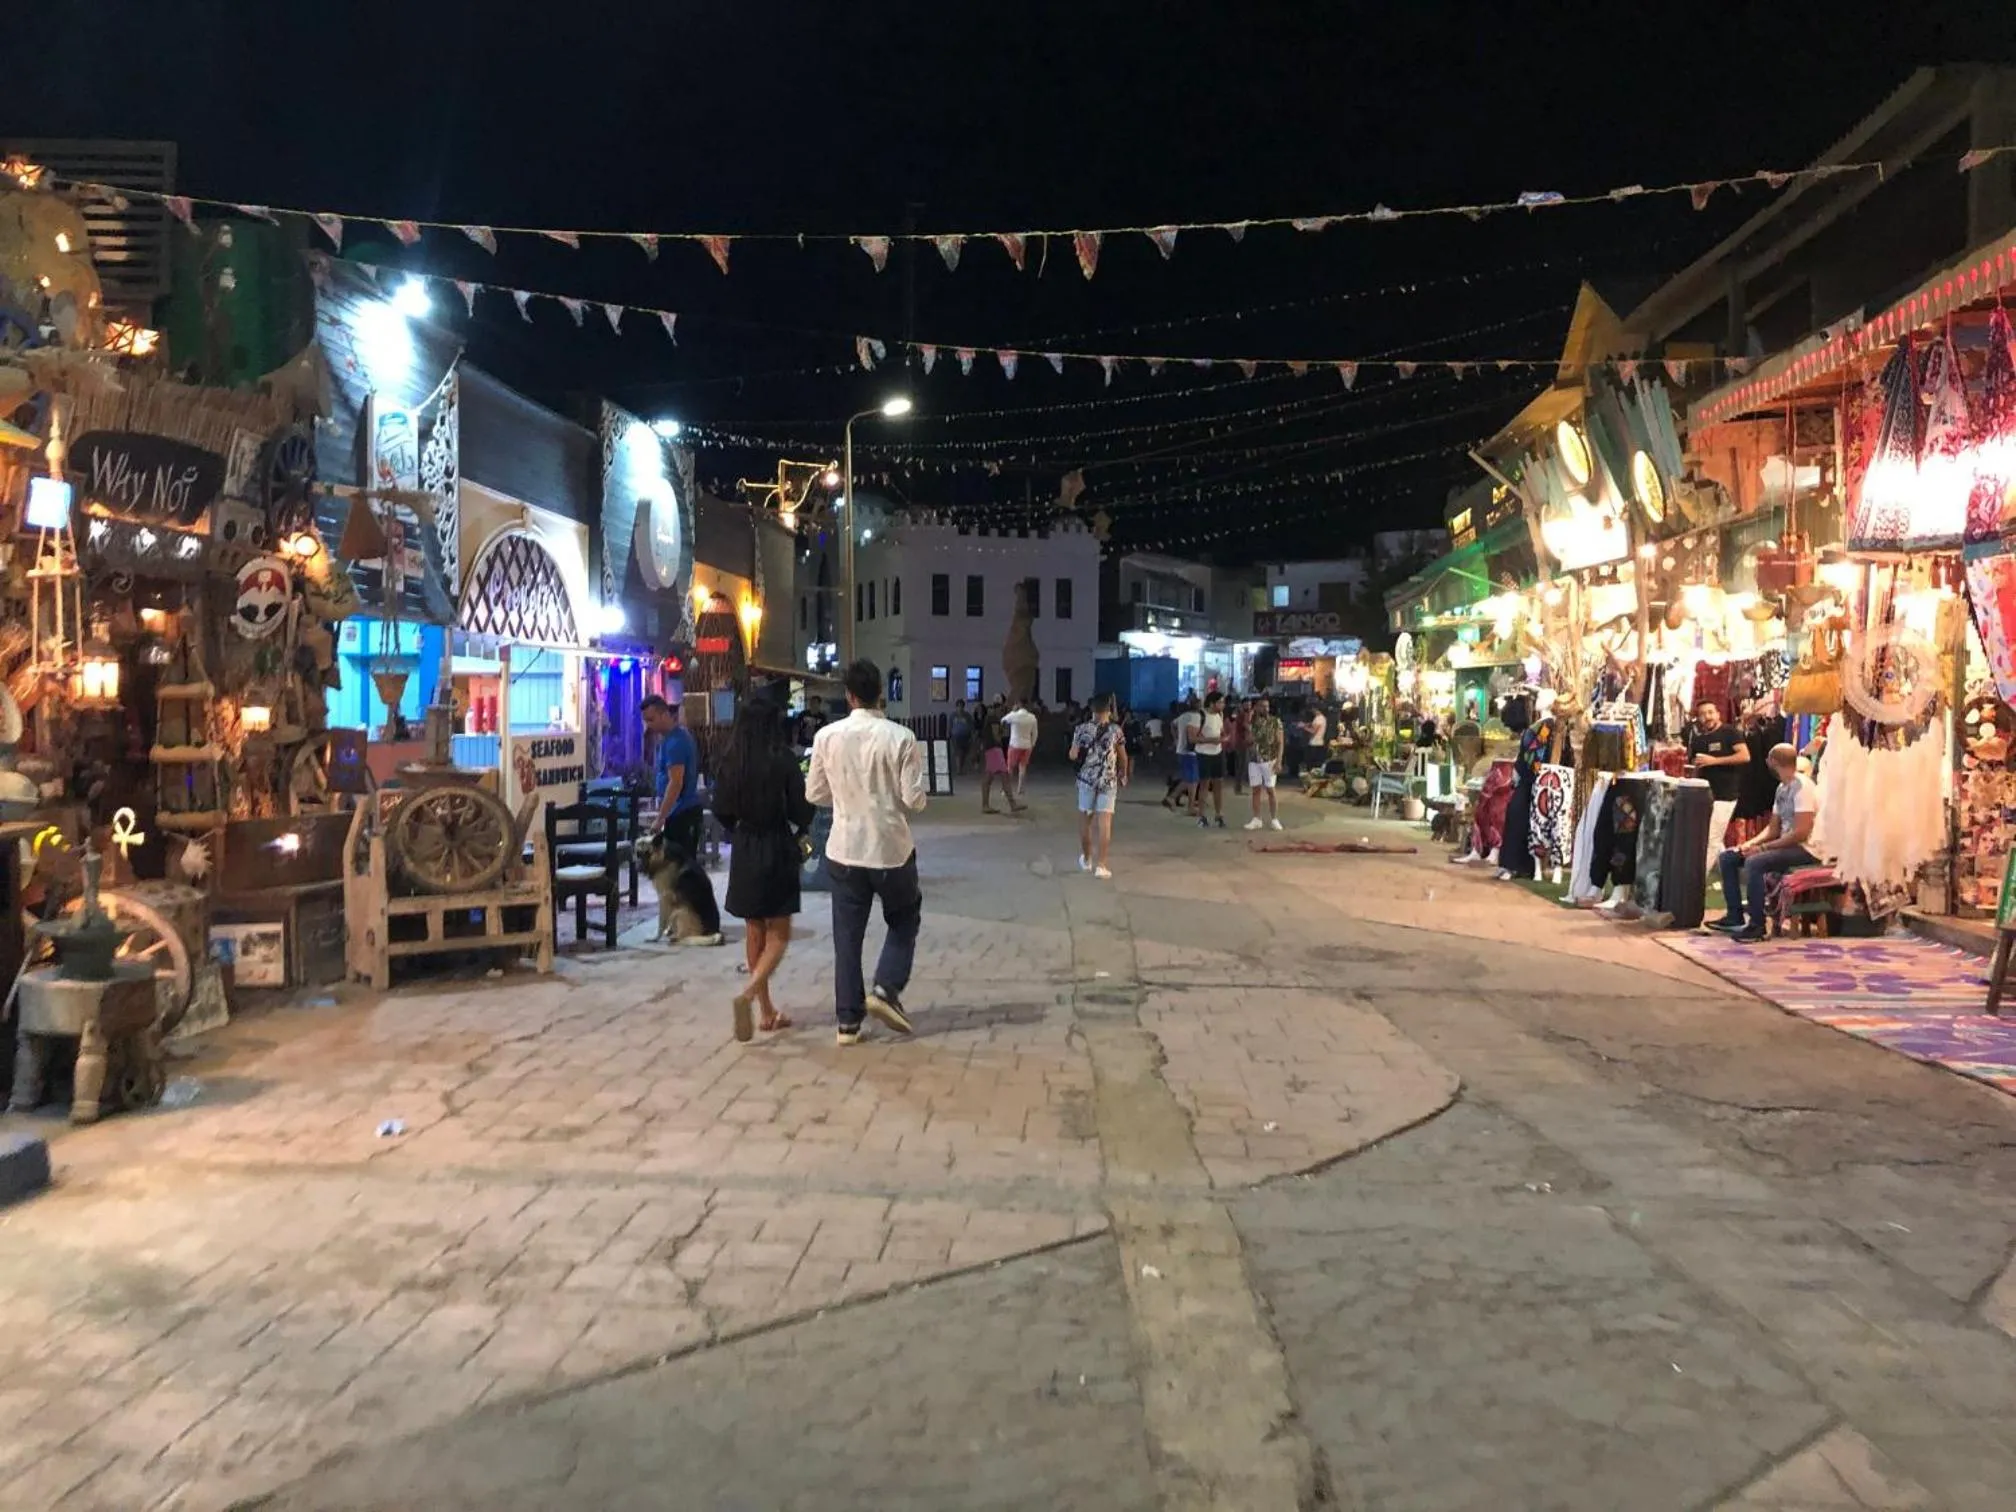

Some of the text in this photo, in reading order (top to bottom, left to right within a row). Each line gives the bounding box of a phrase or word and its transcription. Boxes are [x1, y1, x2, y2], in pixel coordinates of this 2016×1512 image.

[1276, 612, 1340, 634] TANGO
[531, 738, 575, 759] SEAFOOD
[535, 764, 584, 787] SANDWICH
